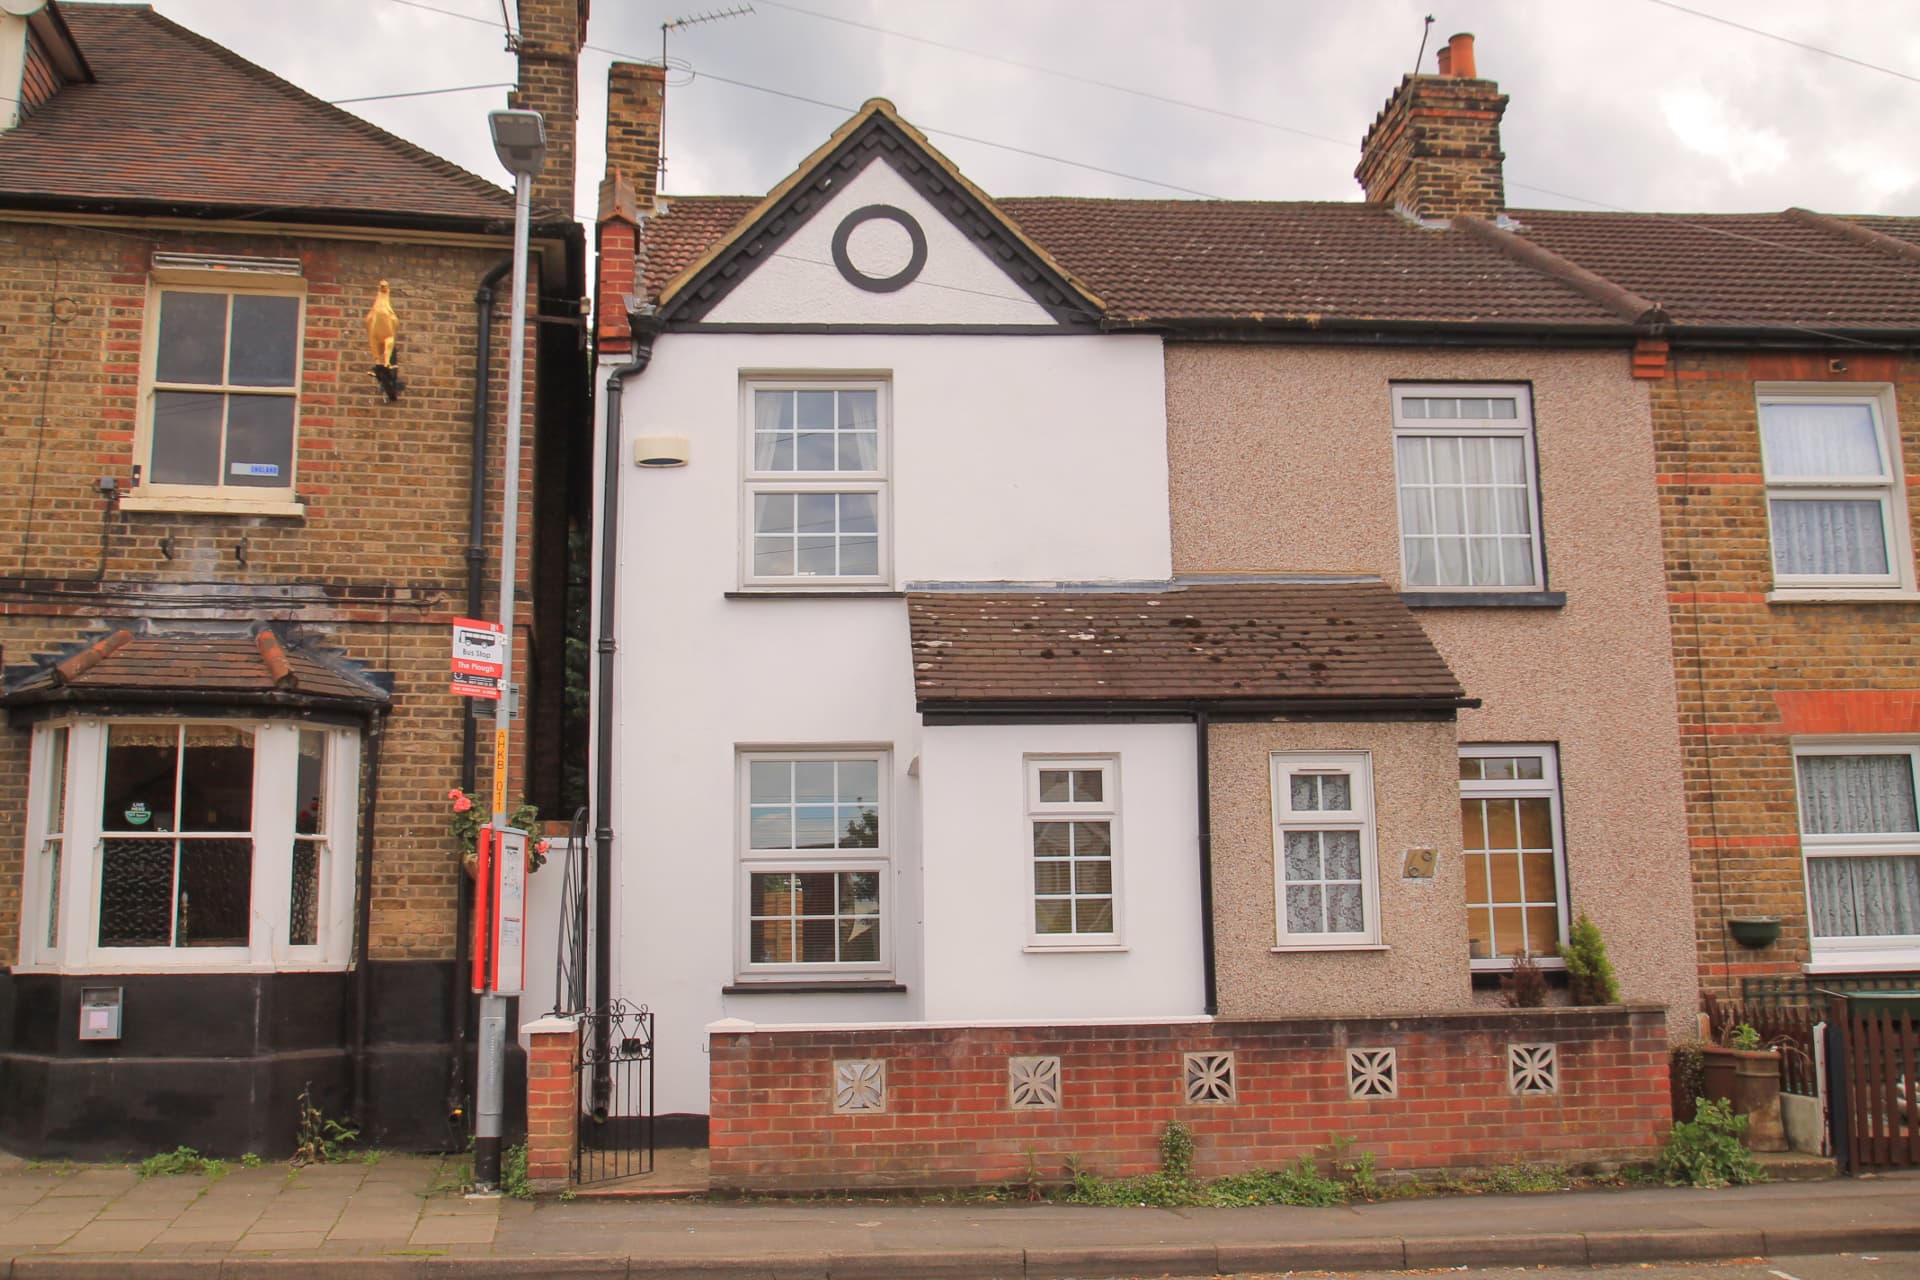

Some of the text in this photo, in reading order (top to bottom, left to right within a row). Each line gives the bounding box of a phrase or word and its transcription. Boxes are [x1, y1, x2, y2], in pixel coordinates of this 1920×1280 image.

[463, 648, 492, 659] Bus Stop
[457, 661, 495, 674] The Plough
